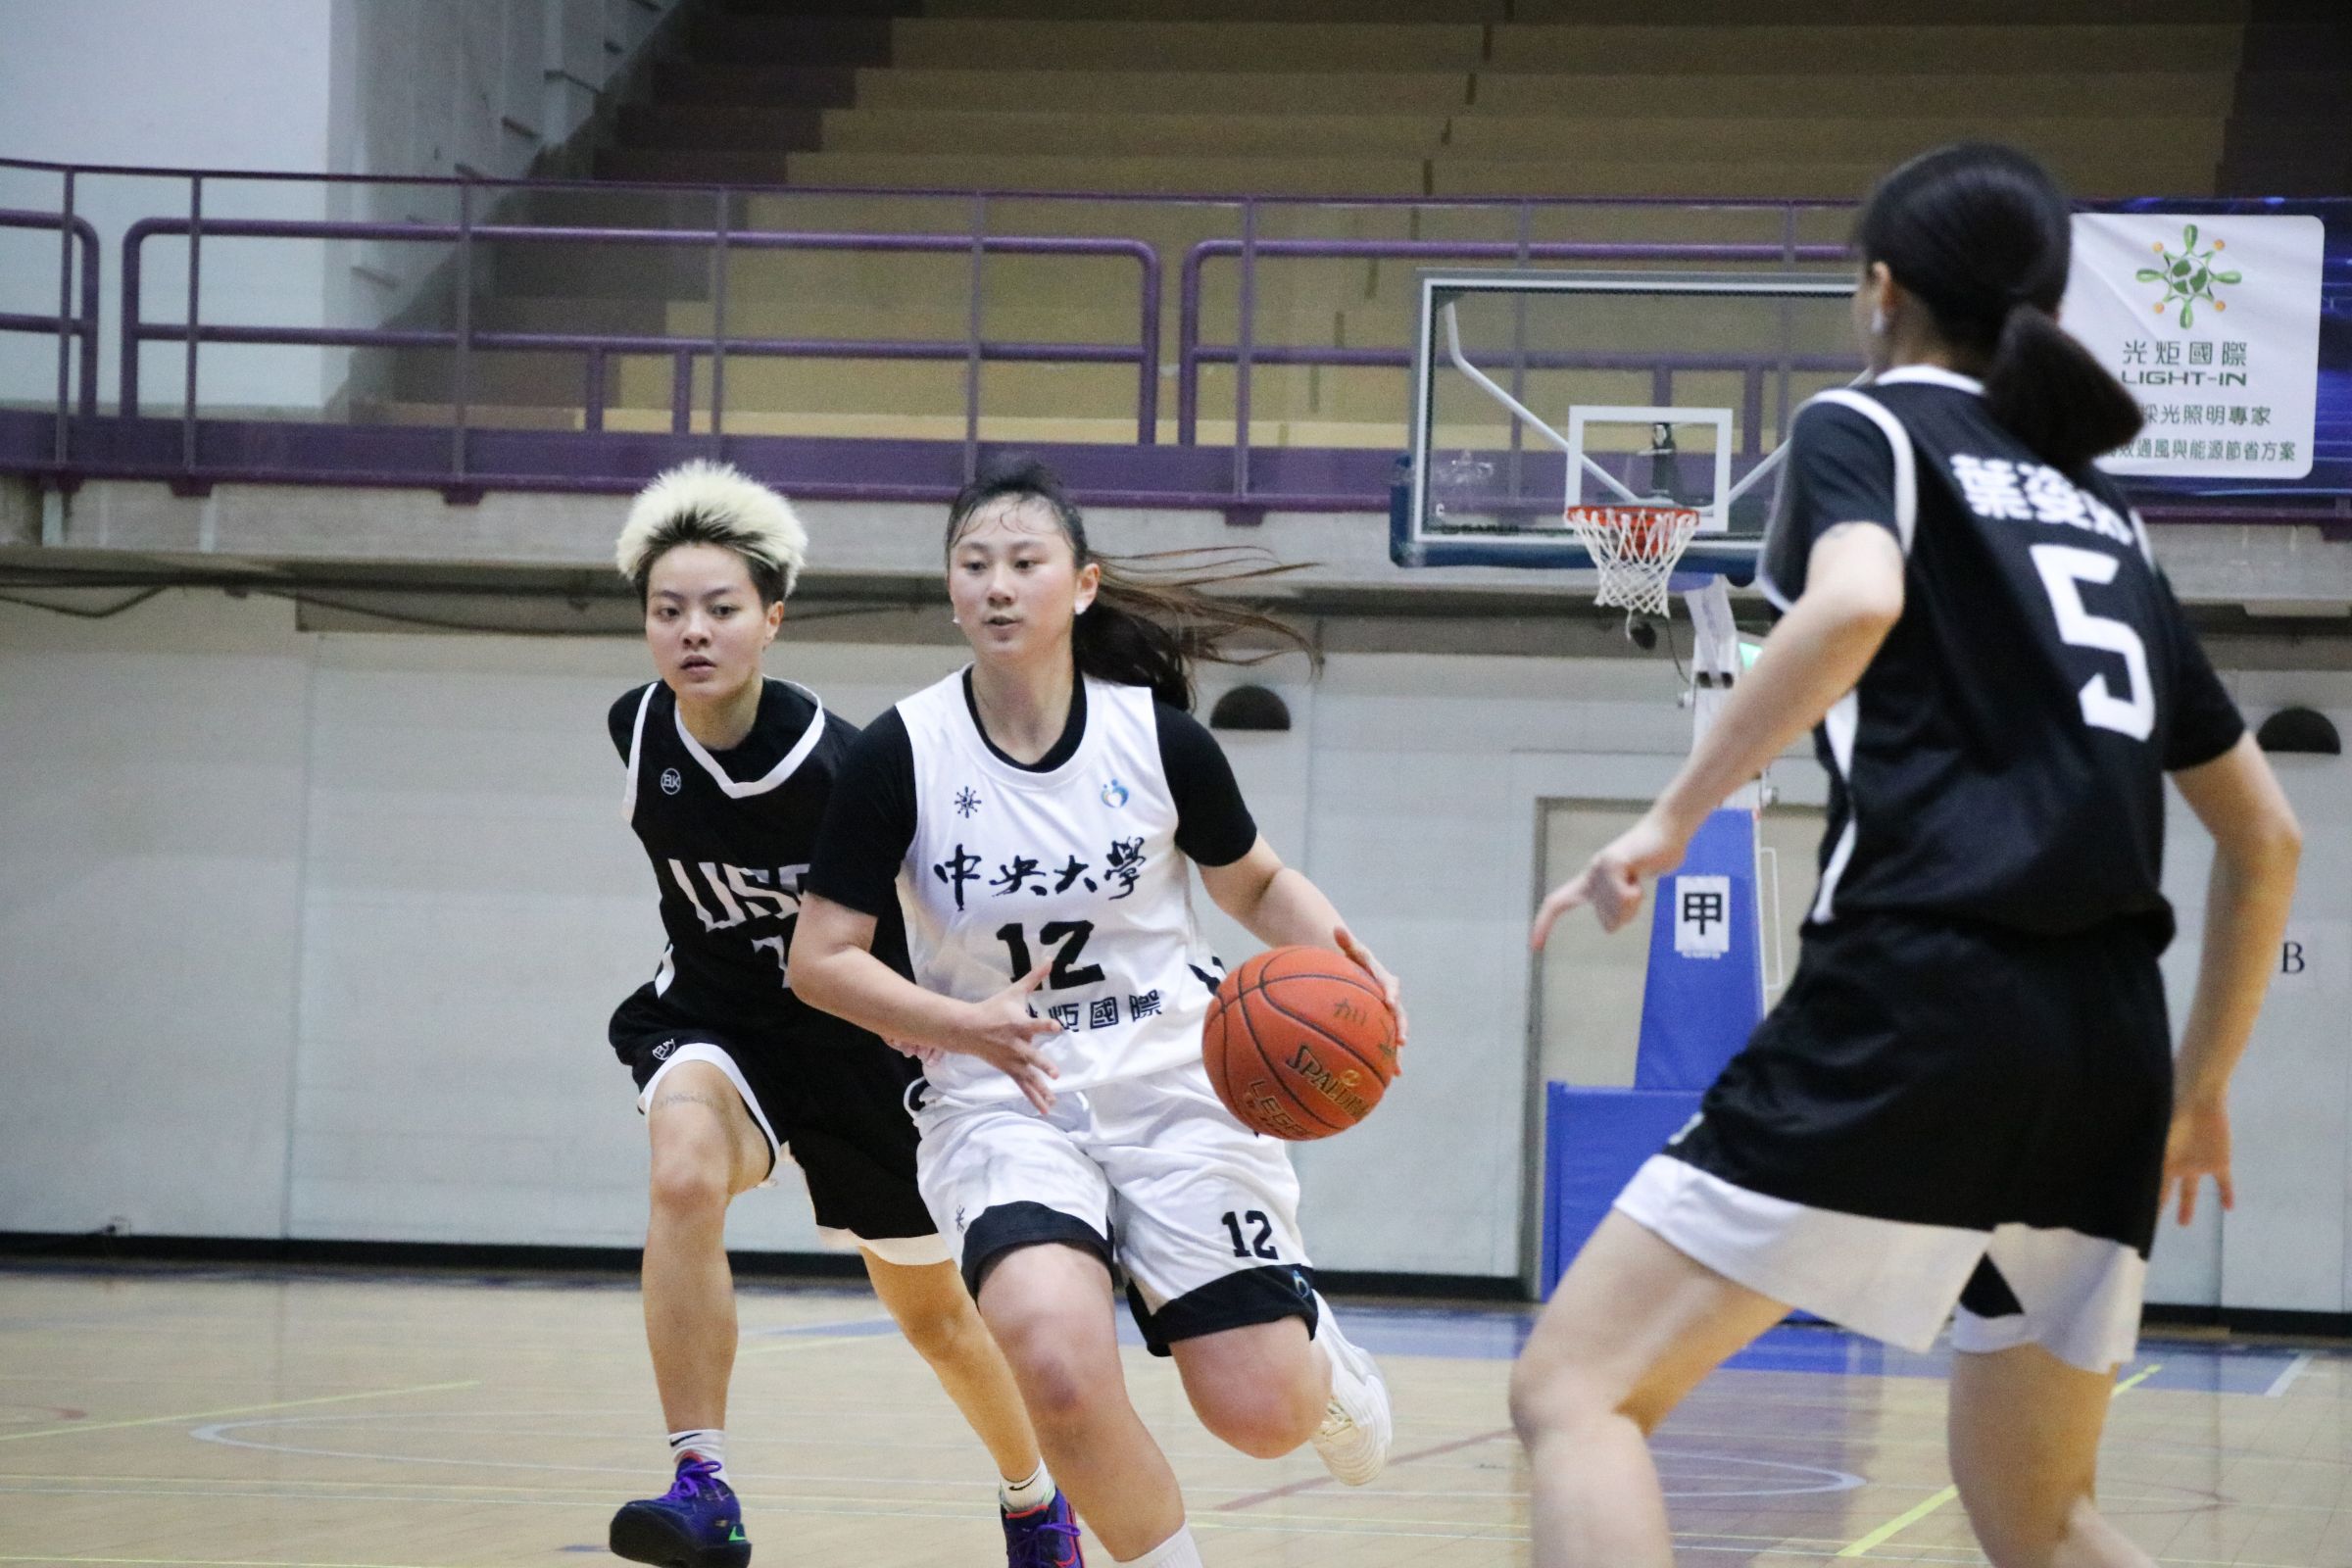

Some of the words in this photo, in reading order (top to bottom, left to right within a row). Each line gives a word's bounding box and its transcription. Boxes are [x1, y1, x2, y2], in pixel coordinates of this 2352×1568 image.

[2123, 340, 2247, 367] 光炬國際
[2121, 370, 2247, 387] LIGHT-IN
[2109, 438, 2296, 462] 效通風與能源節省方案
[2030, 543, 2155, 742] 5
[934, 836, 1147, 912] 中央大學
[1684, 892, 1723, 936] 甲
[996, 919, 1105, 992] 12
[2281, 941, 2306, 974] B
[1025, 989, 1162, 1032] 炬國際
[1220, 1209, 1279, 1260] 12
